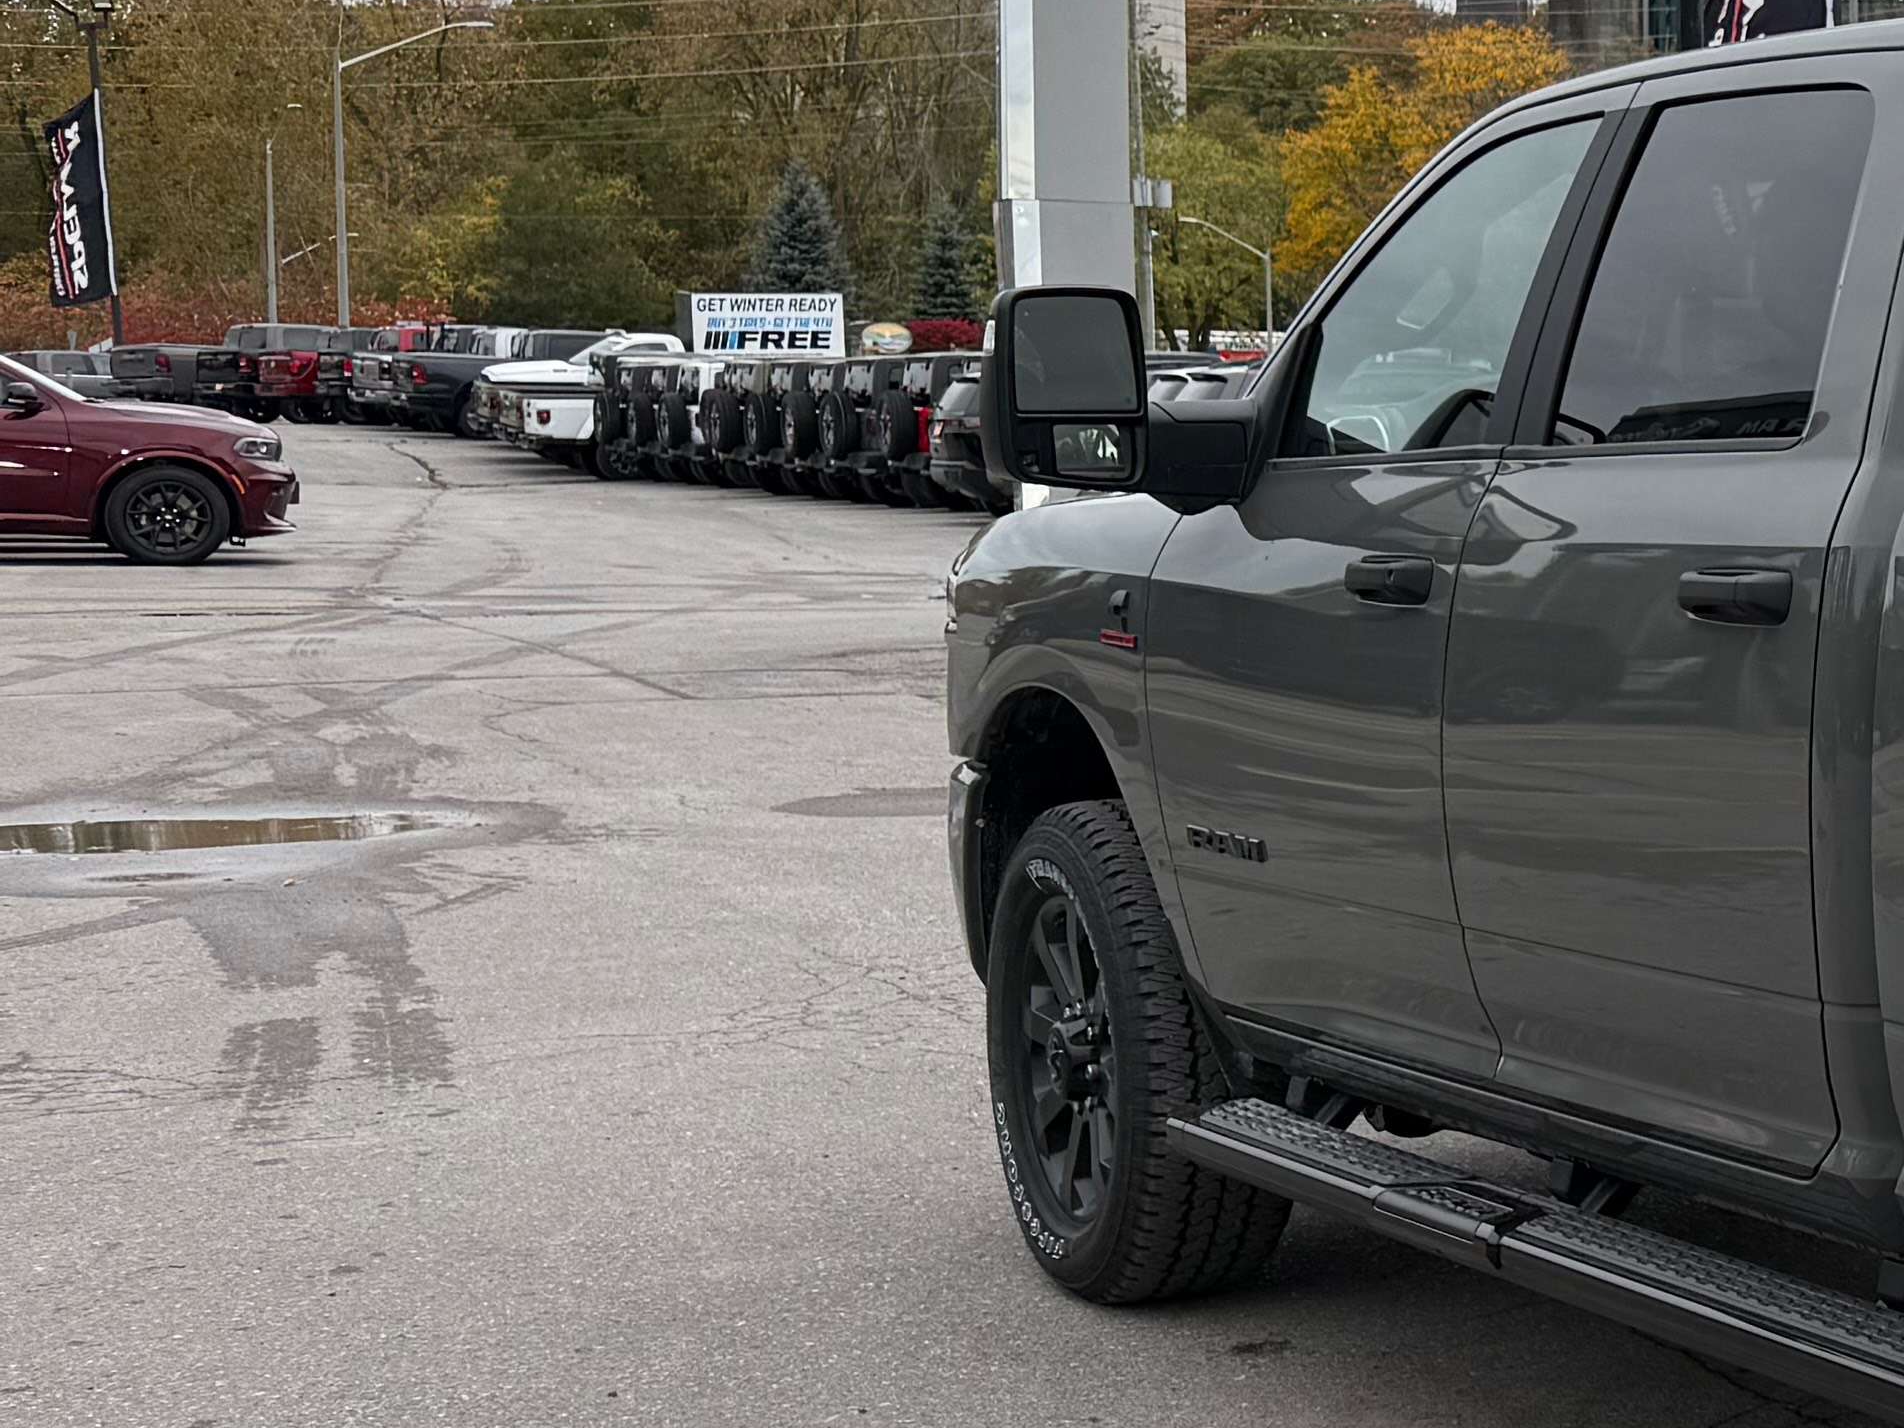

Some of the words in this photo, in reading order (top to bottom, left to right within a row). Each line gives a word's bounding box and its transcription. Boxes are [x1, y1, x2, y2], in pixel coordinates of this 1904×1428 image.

[697, 298, 726, 312] GET
[729, 298, 784, 312] WINTER
[789, 298, 837, 312] READY
[735, 330, 831, 349] FREE
[1186, 824, 1269, 863] RAM
